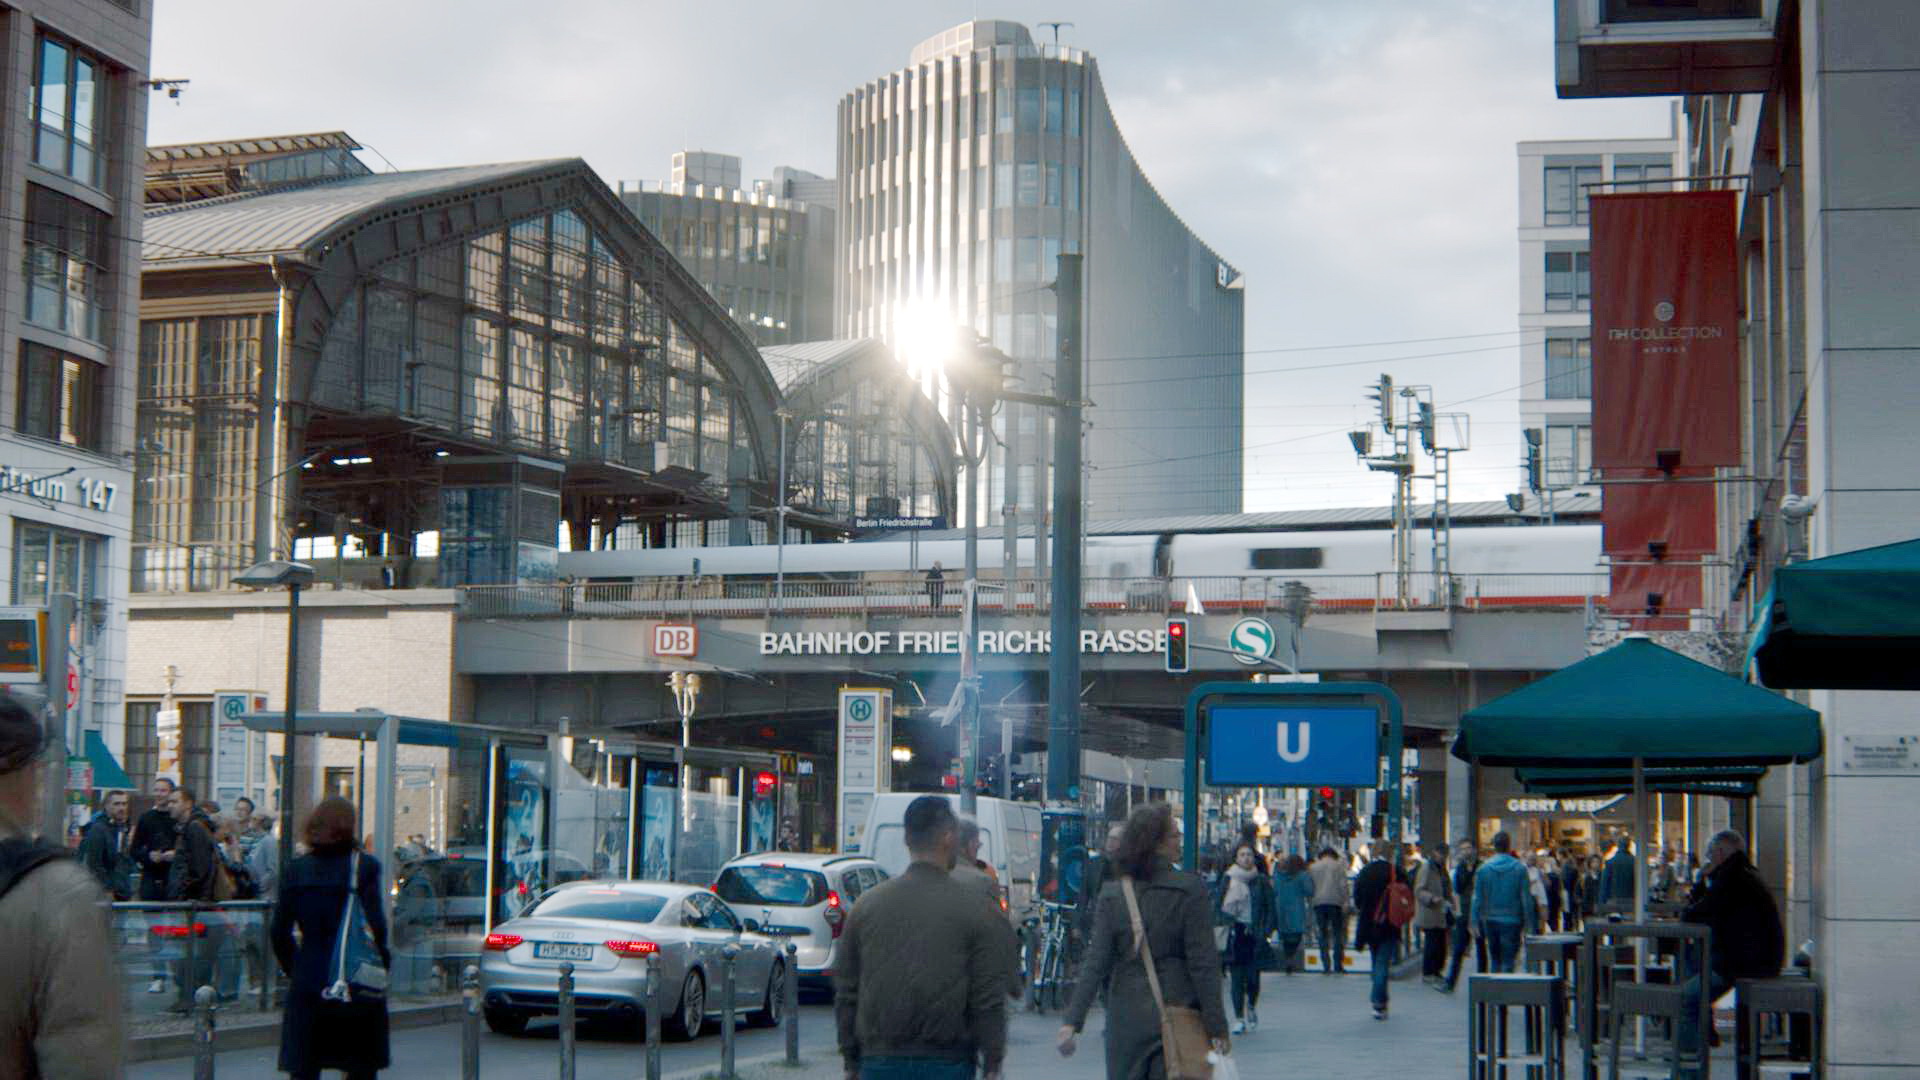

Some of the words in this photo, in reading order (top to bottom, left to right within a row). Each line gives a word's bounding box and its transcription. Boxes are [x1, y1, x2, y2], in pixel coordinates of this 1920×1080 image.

[1631, 326, 1721, 341] COLLECTION
[80, 477, 118, 512] 147
[856, 519, 878, 528] Berlin
[660, 630, 690, 651] DB
[759, 631, 891, 655] BAHNHOF
[1235, 623, 1268, 661] S
[1277, 721, 1310, 763] U
[1507, 798, 1558, 813] GERRY
